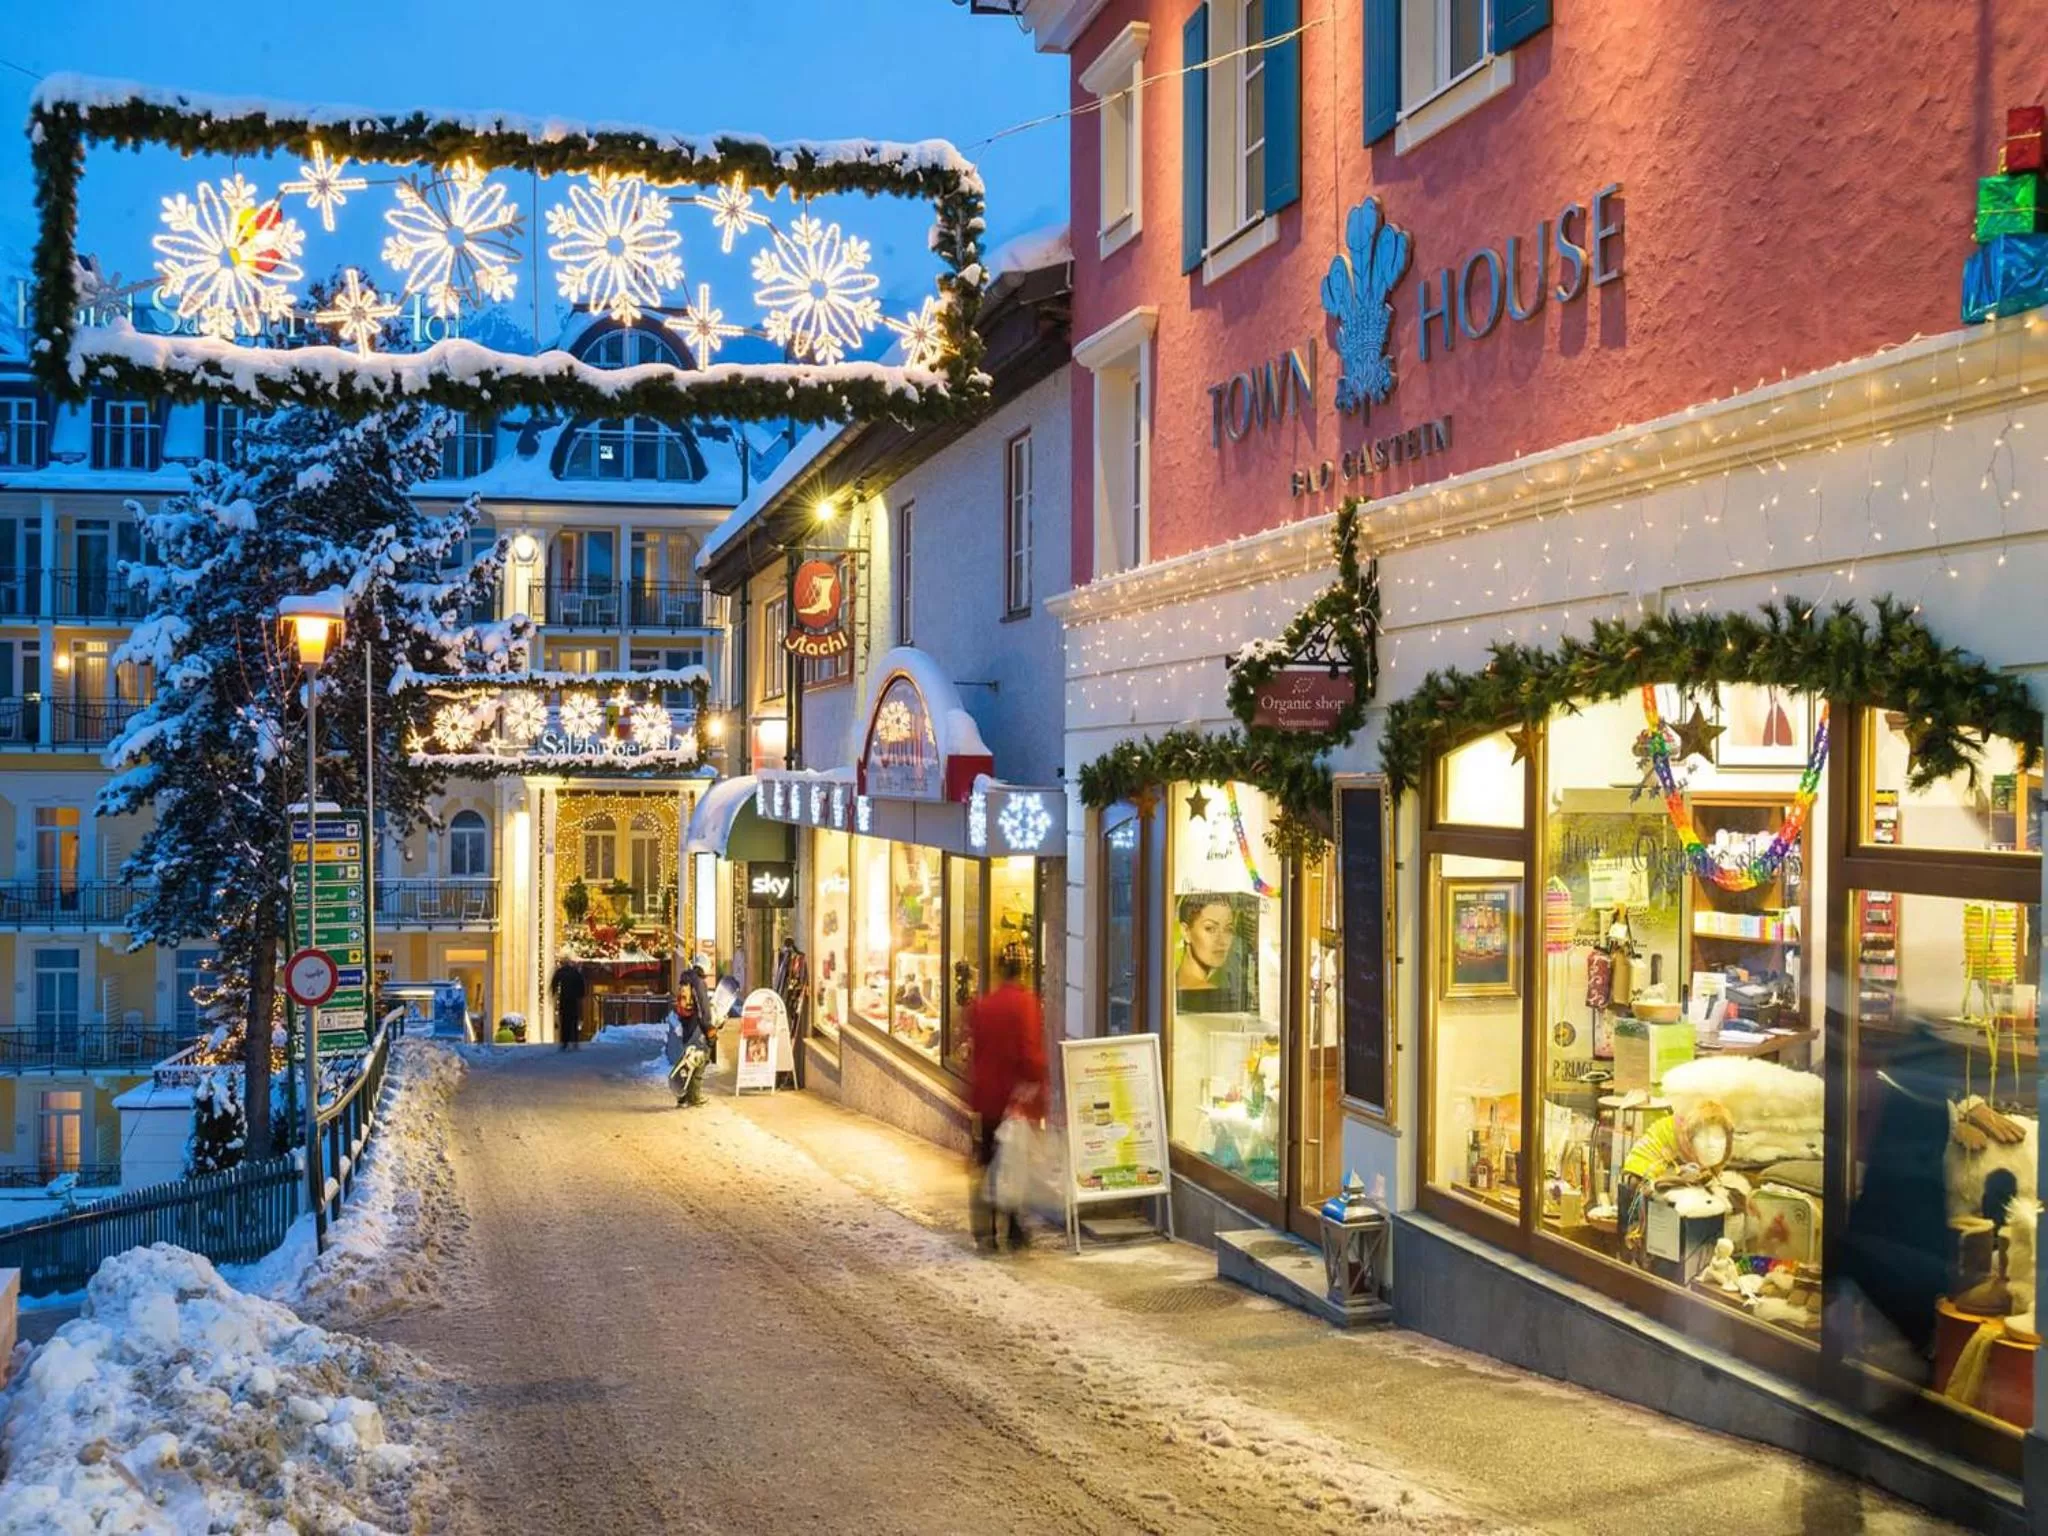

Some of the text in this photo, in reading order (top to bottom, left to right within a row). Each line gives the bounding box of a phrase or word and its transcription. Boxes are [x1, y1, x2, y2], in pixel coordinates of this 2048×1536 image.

[1208, 182, 1624, 448] TOWN HOUSE
[1292, 415, 1452, 497] BAD GASTEIN
[785, 631, 848, 655] Stachl
[1261, 695, 1344, 715] Organic shop
[540, 730, 645, 757] Salzbuger
[752, 872, 790, 898] sky
